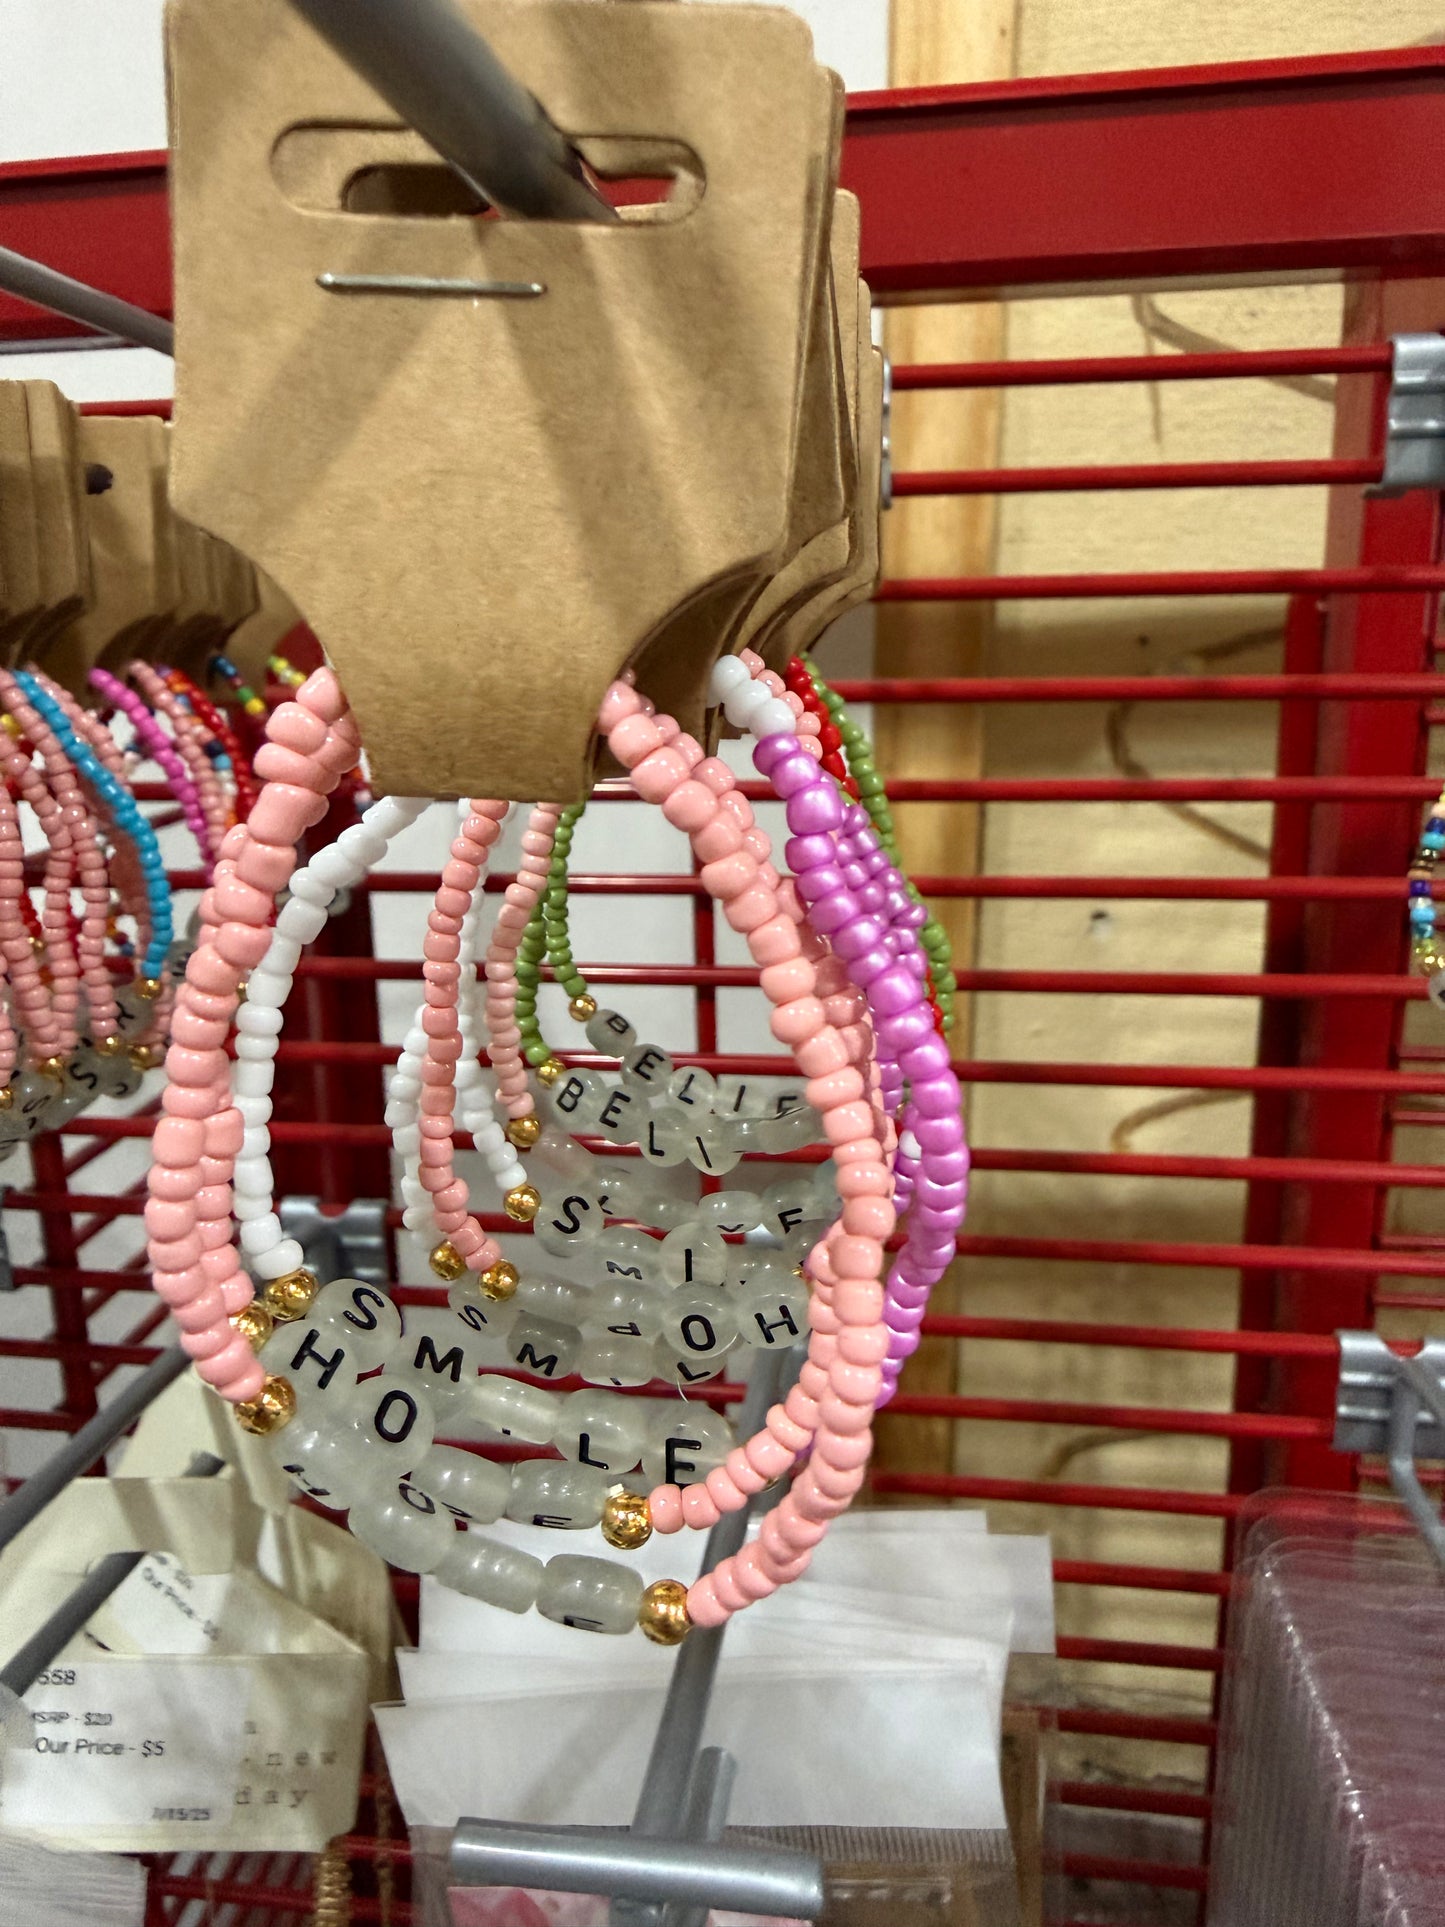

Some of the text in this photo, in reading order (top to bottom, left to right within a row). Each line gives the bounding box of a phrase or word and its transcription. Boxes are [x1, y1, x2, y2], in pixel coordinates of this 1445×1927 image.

[35, 1736, 70, 1755] Our
[75, 1738, 125, 1756] Price
[141, 1739, 167, 1758] $5
